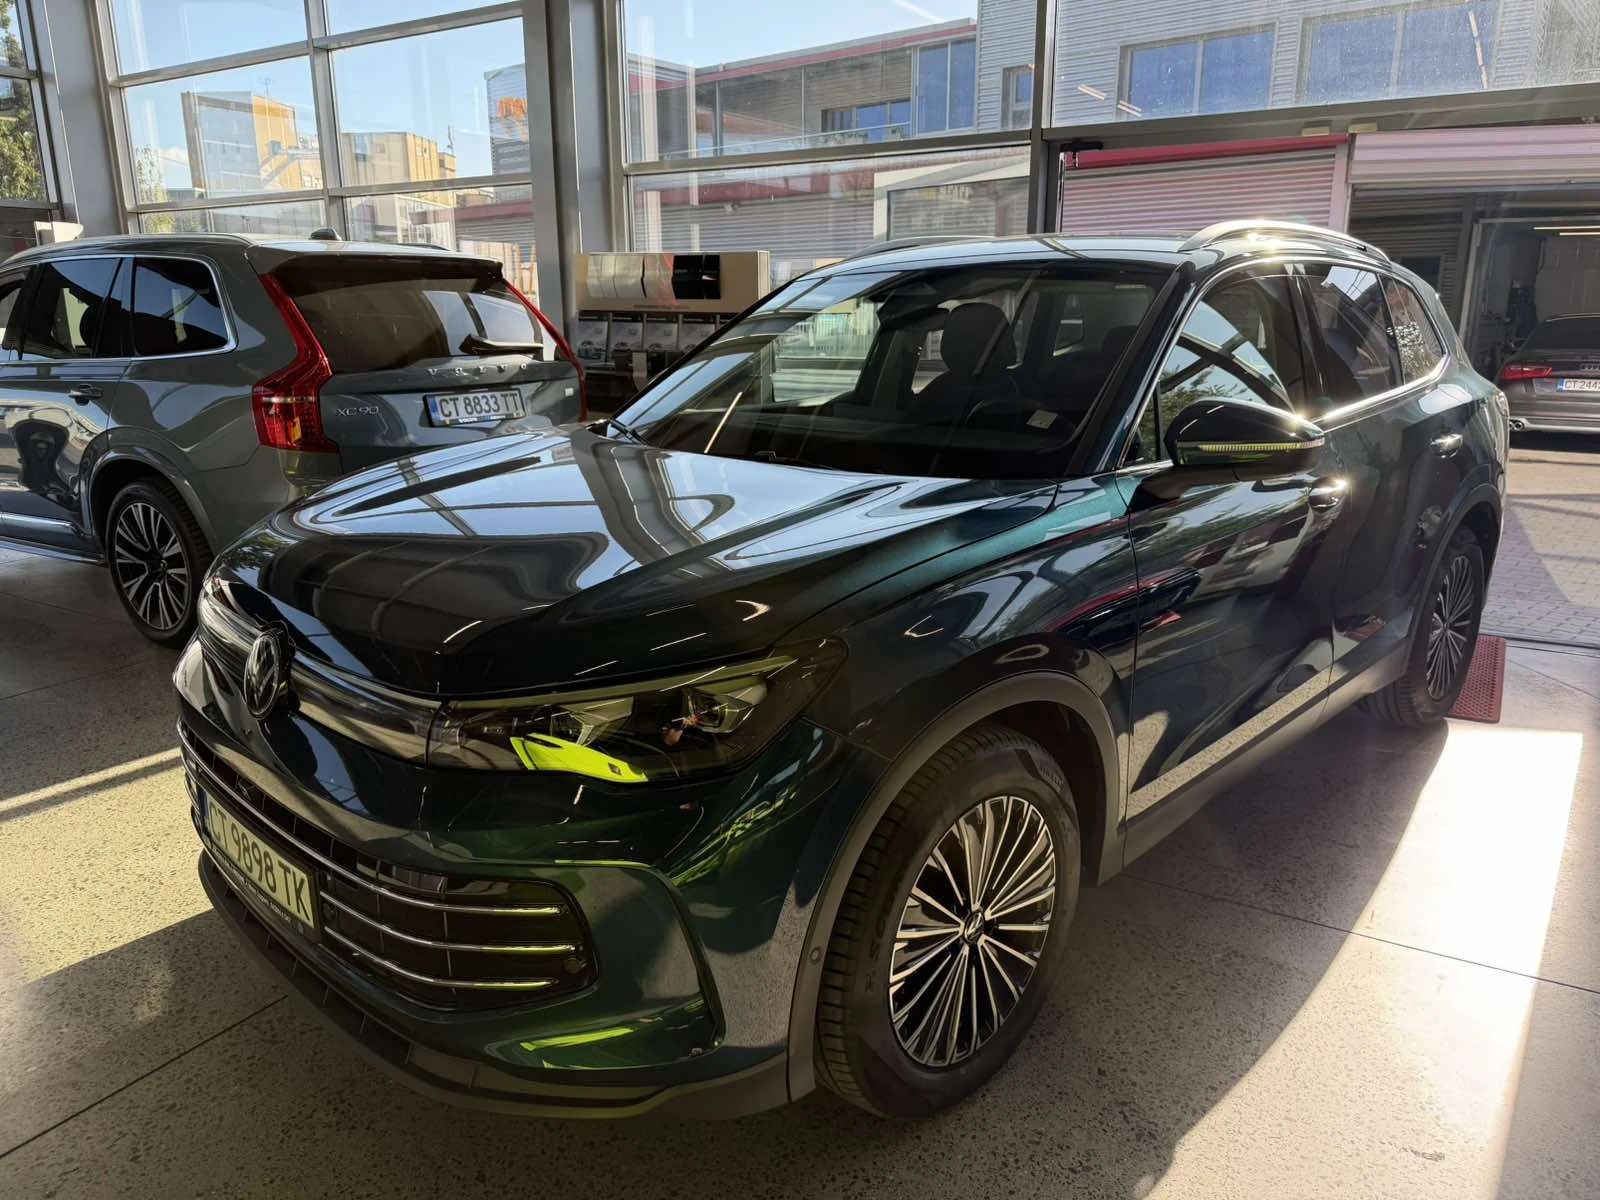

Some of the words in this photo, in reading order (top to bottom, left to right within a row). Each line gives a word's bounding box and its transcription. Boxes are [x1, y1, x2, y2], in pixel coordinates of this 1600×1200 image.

[1579, 380, 1600, 390] 244
[336, 406, 379, 417] XC90
[439, 397, 461, 418] CT
[463, 394, 501, 416] 8833
[501, 393, 519, 412] TT
[208, 800, 229, 851] CT
[230, 821, 278, 895] 9898
[277, 859, 311, 923] TK
